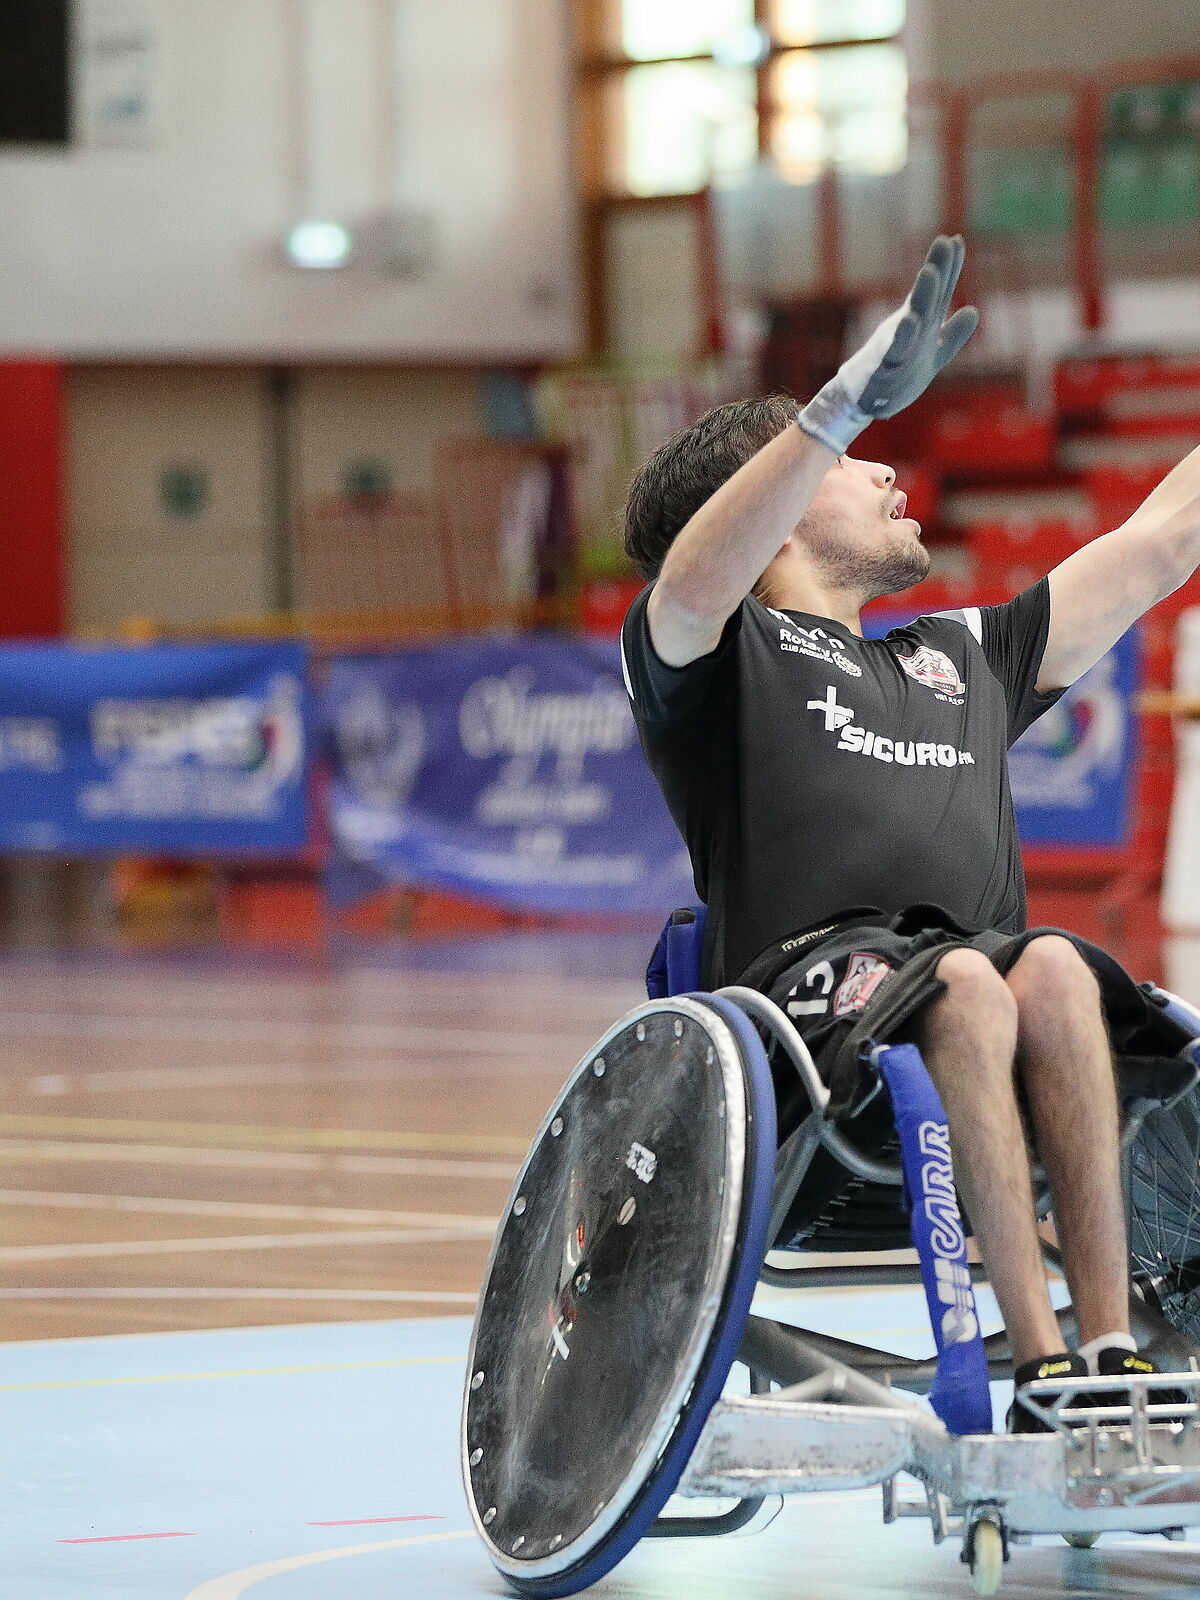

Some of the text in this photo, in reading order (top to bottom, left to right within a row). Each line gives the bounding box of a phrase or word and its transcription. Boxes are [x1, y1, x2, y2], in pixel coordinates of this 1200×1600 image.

[780, 628, 830, 658] Rotary
[780, 643, 799, 653] CLUB
[837, 724, 957, 768] SICURO
